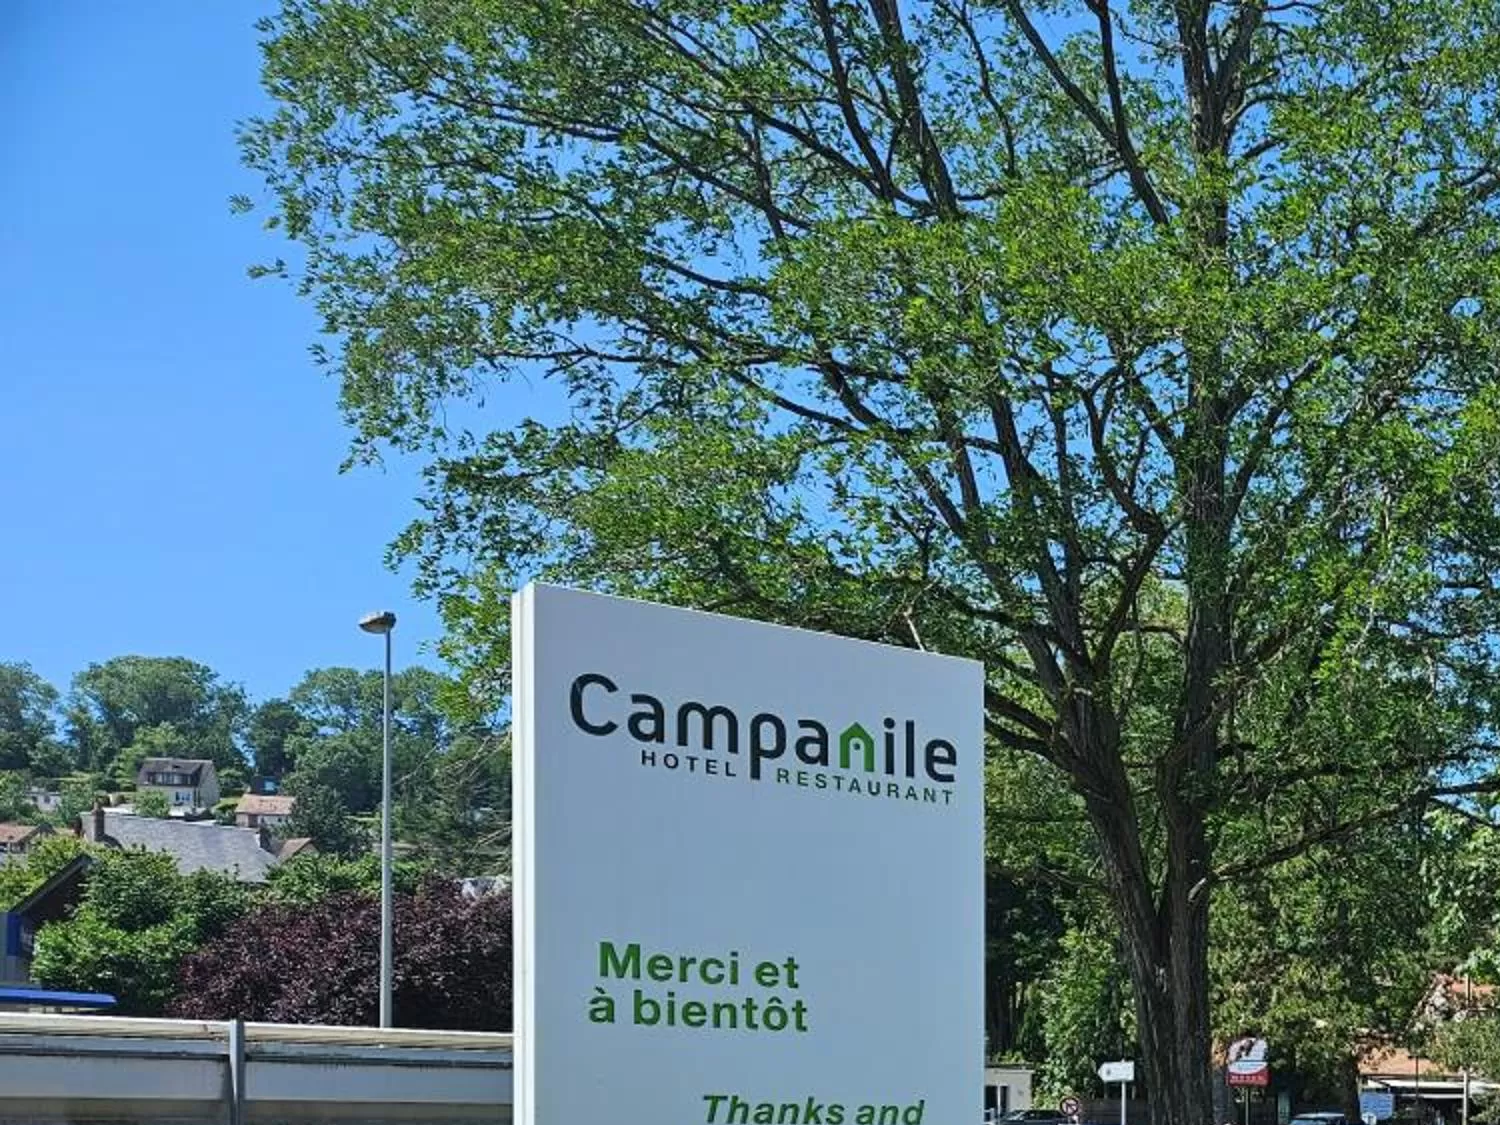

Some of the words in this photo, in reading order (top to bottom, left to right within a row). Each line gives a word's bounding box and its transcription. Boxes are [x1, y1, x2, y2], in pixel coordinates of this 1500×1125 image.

[569, 672, 958, 783] Campanile
[640, 748, 738, 778] HOTEL
[776, 767, 955, 806] RESTAURANT
[598, 941, 740, 987] Merci
[754, 955, 800, 990] et
[588, 987, 616, 1025] à
[633, 989, 809, 1033] bientôt
